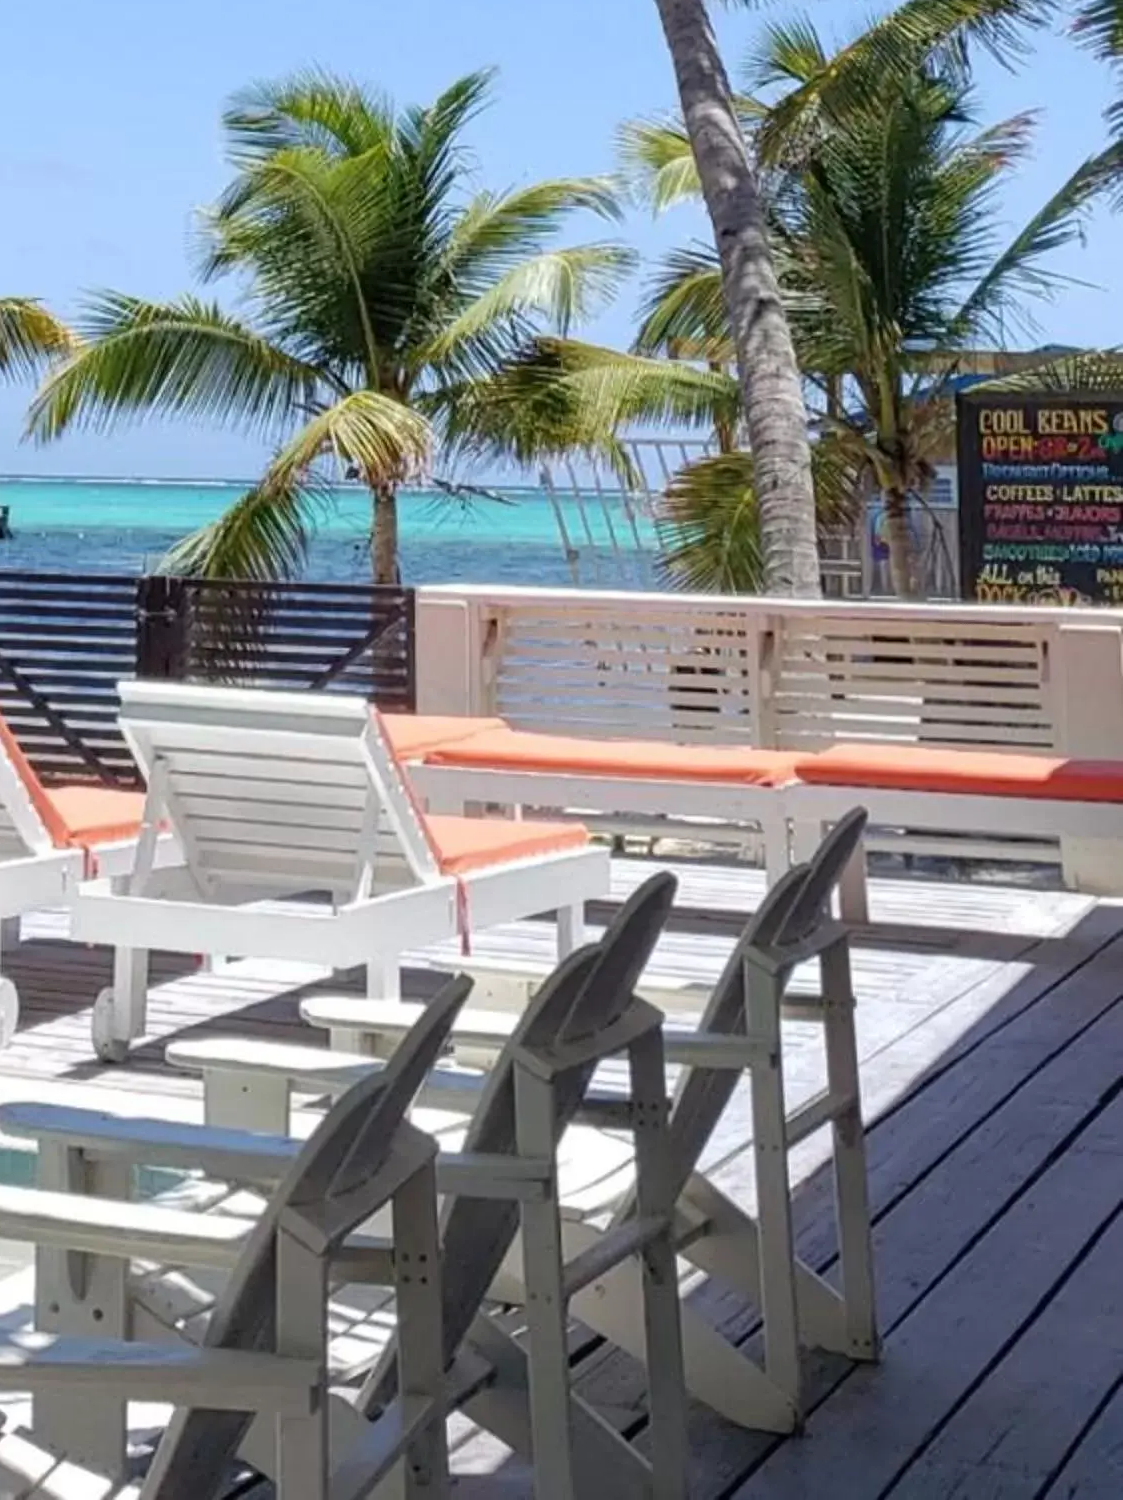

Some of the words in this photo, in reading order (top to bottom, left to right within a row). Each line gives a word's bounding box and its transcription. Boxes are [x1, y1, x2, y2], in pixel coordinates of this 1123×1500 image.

[979, 409, 1032, 434] COOL
[1037, 409, 1109, 434] BEANS
[986, 484, 1053, 501] COFFEES
[977, 564, 1013, 584] ALL
